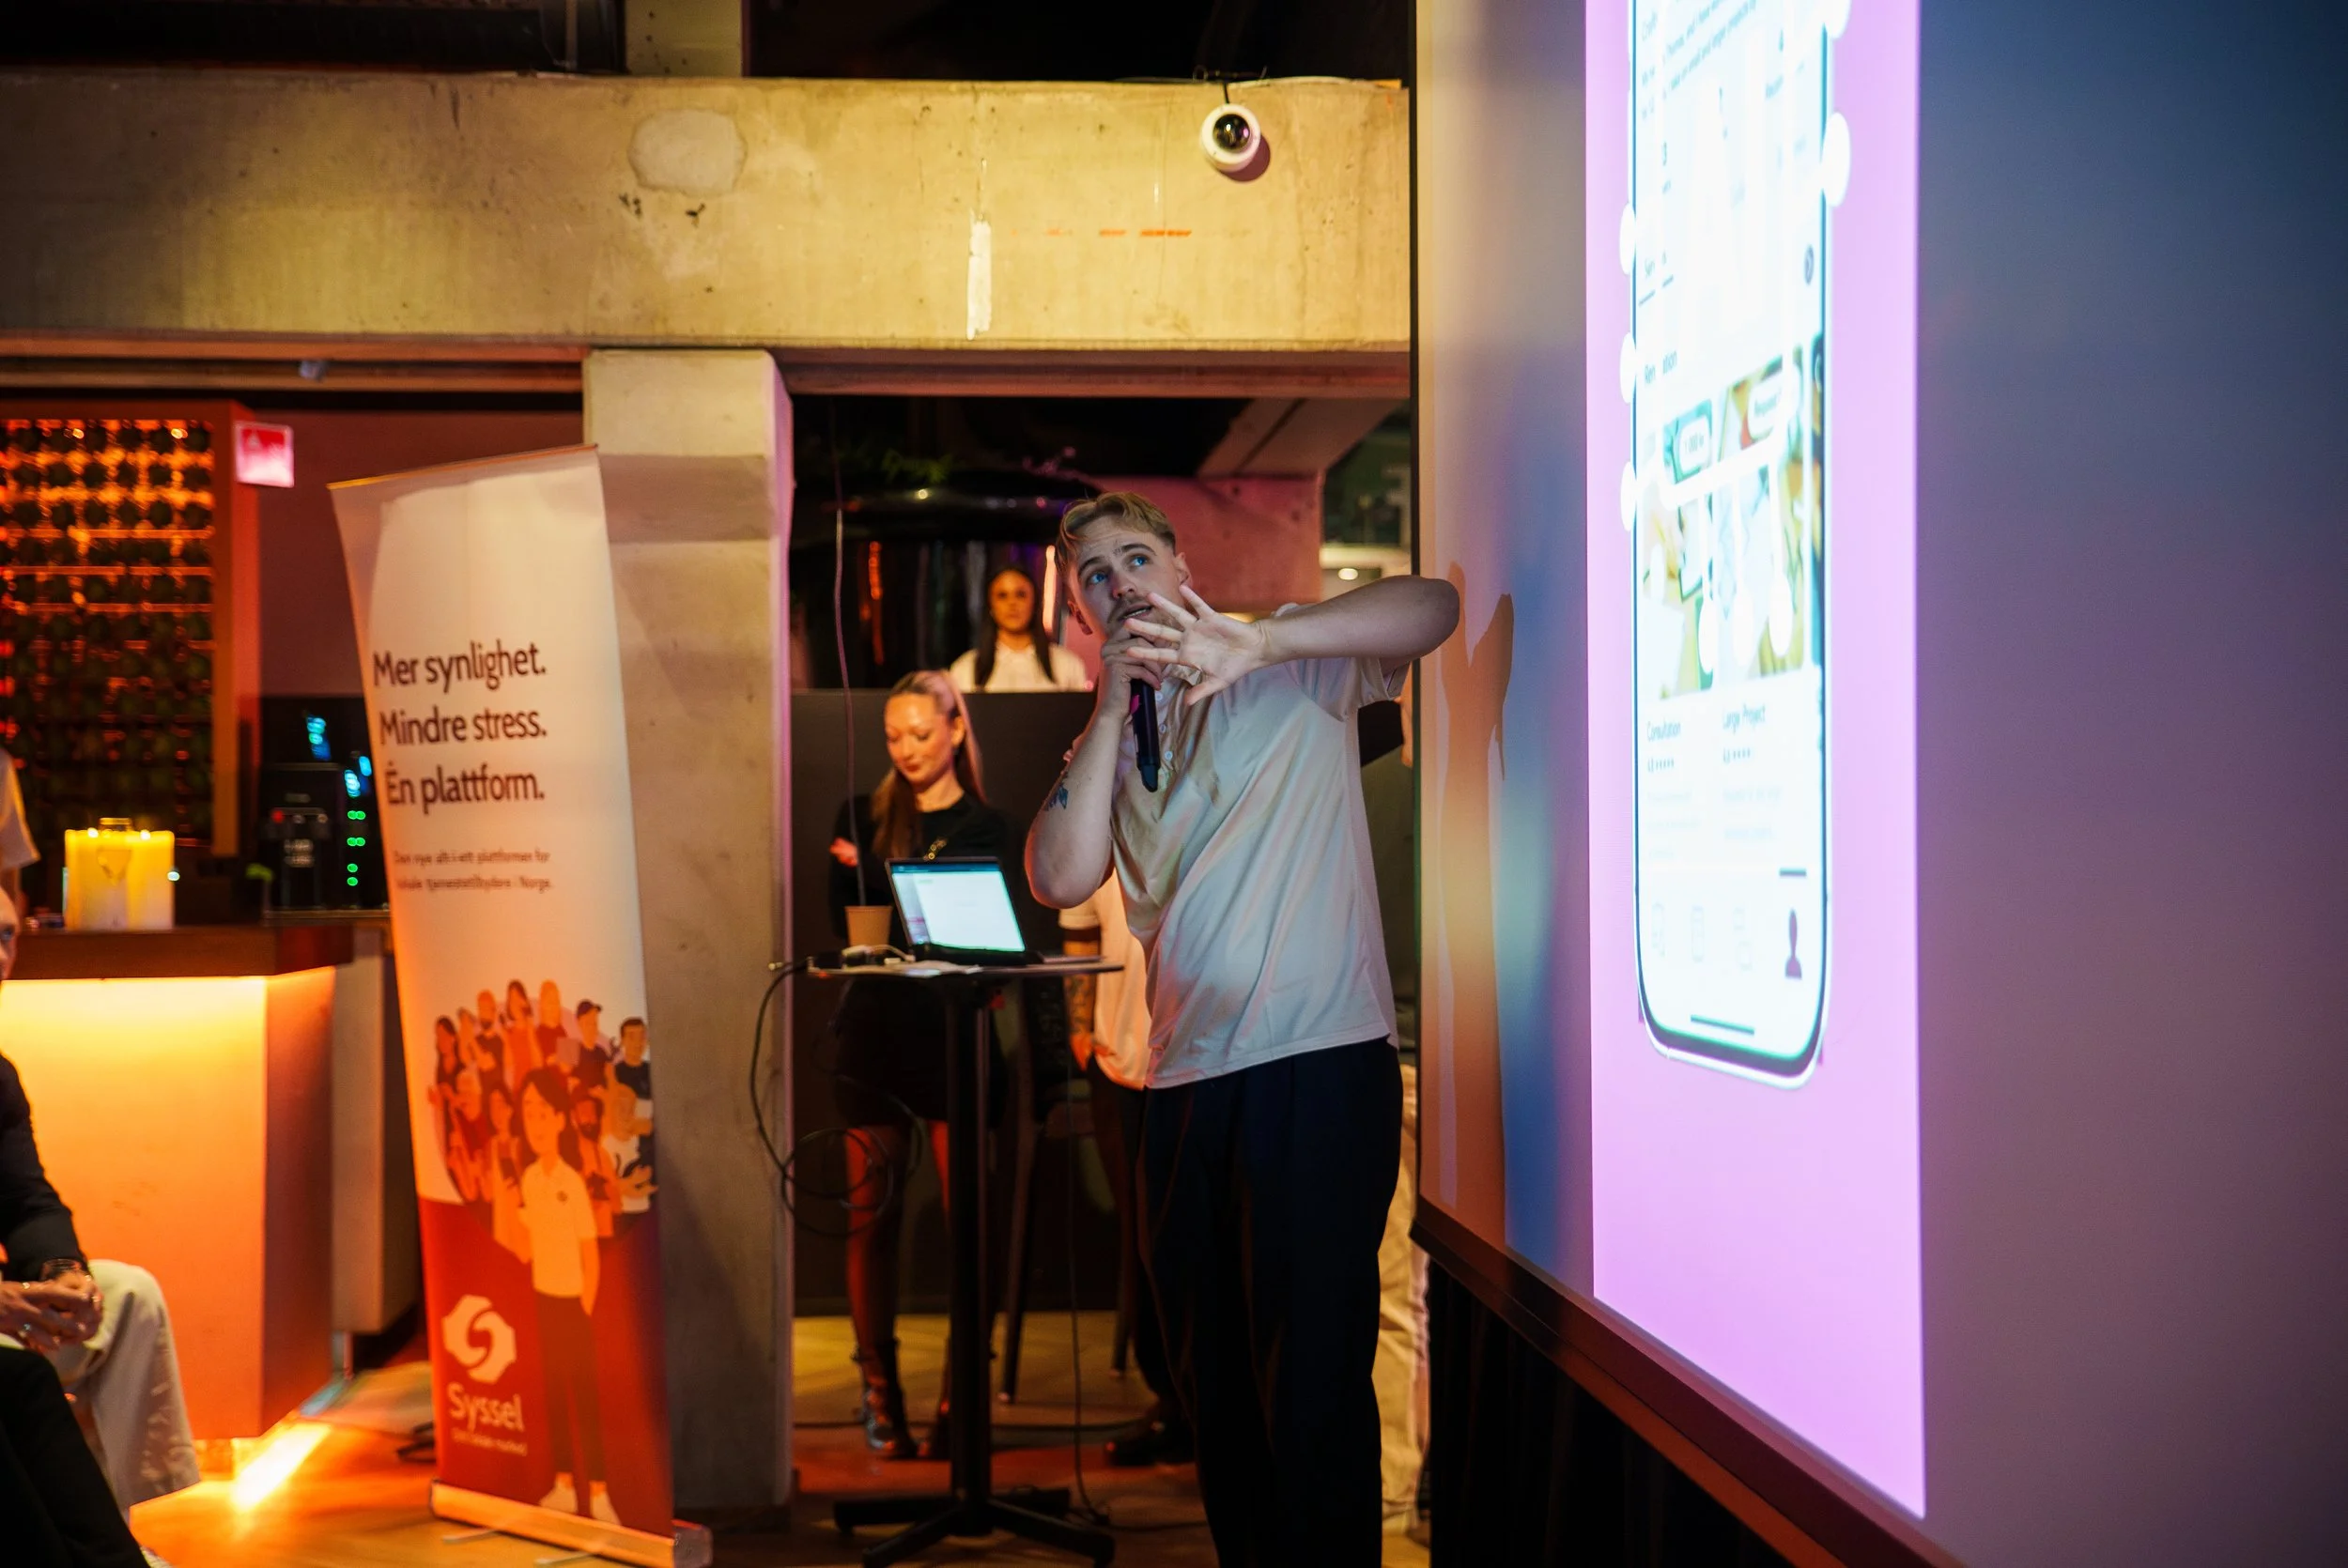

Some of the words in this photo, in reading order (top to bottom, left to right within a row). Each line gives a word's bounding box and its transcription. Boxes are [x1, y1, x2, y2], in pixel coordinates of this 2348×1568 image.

[372, 650, 418, 686] Mer
[425, 638, 547, 694] synlighet.
[379, 704, 468, 746] Mindre
[472, 707, 548, 741] stress.
[384, 761, 416, 806] Én
[420, 761, 546, 815] plattform.
[446, 1380, 525, 1433] Syssel
